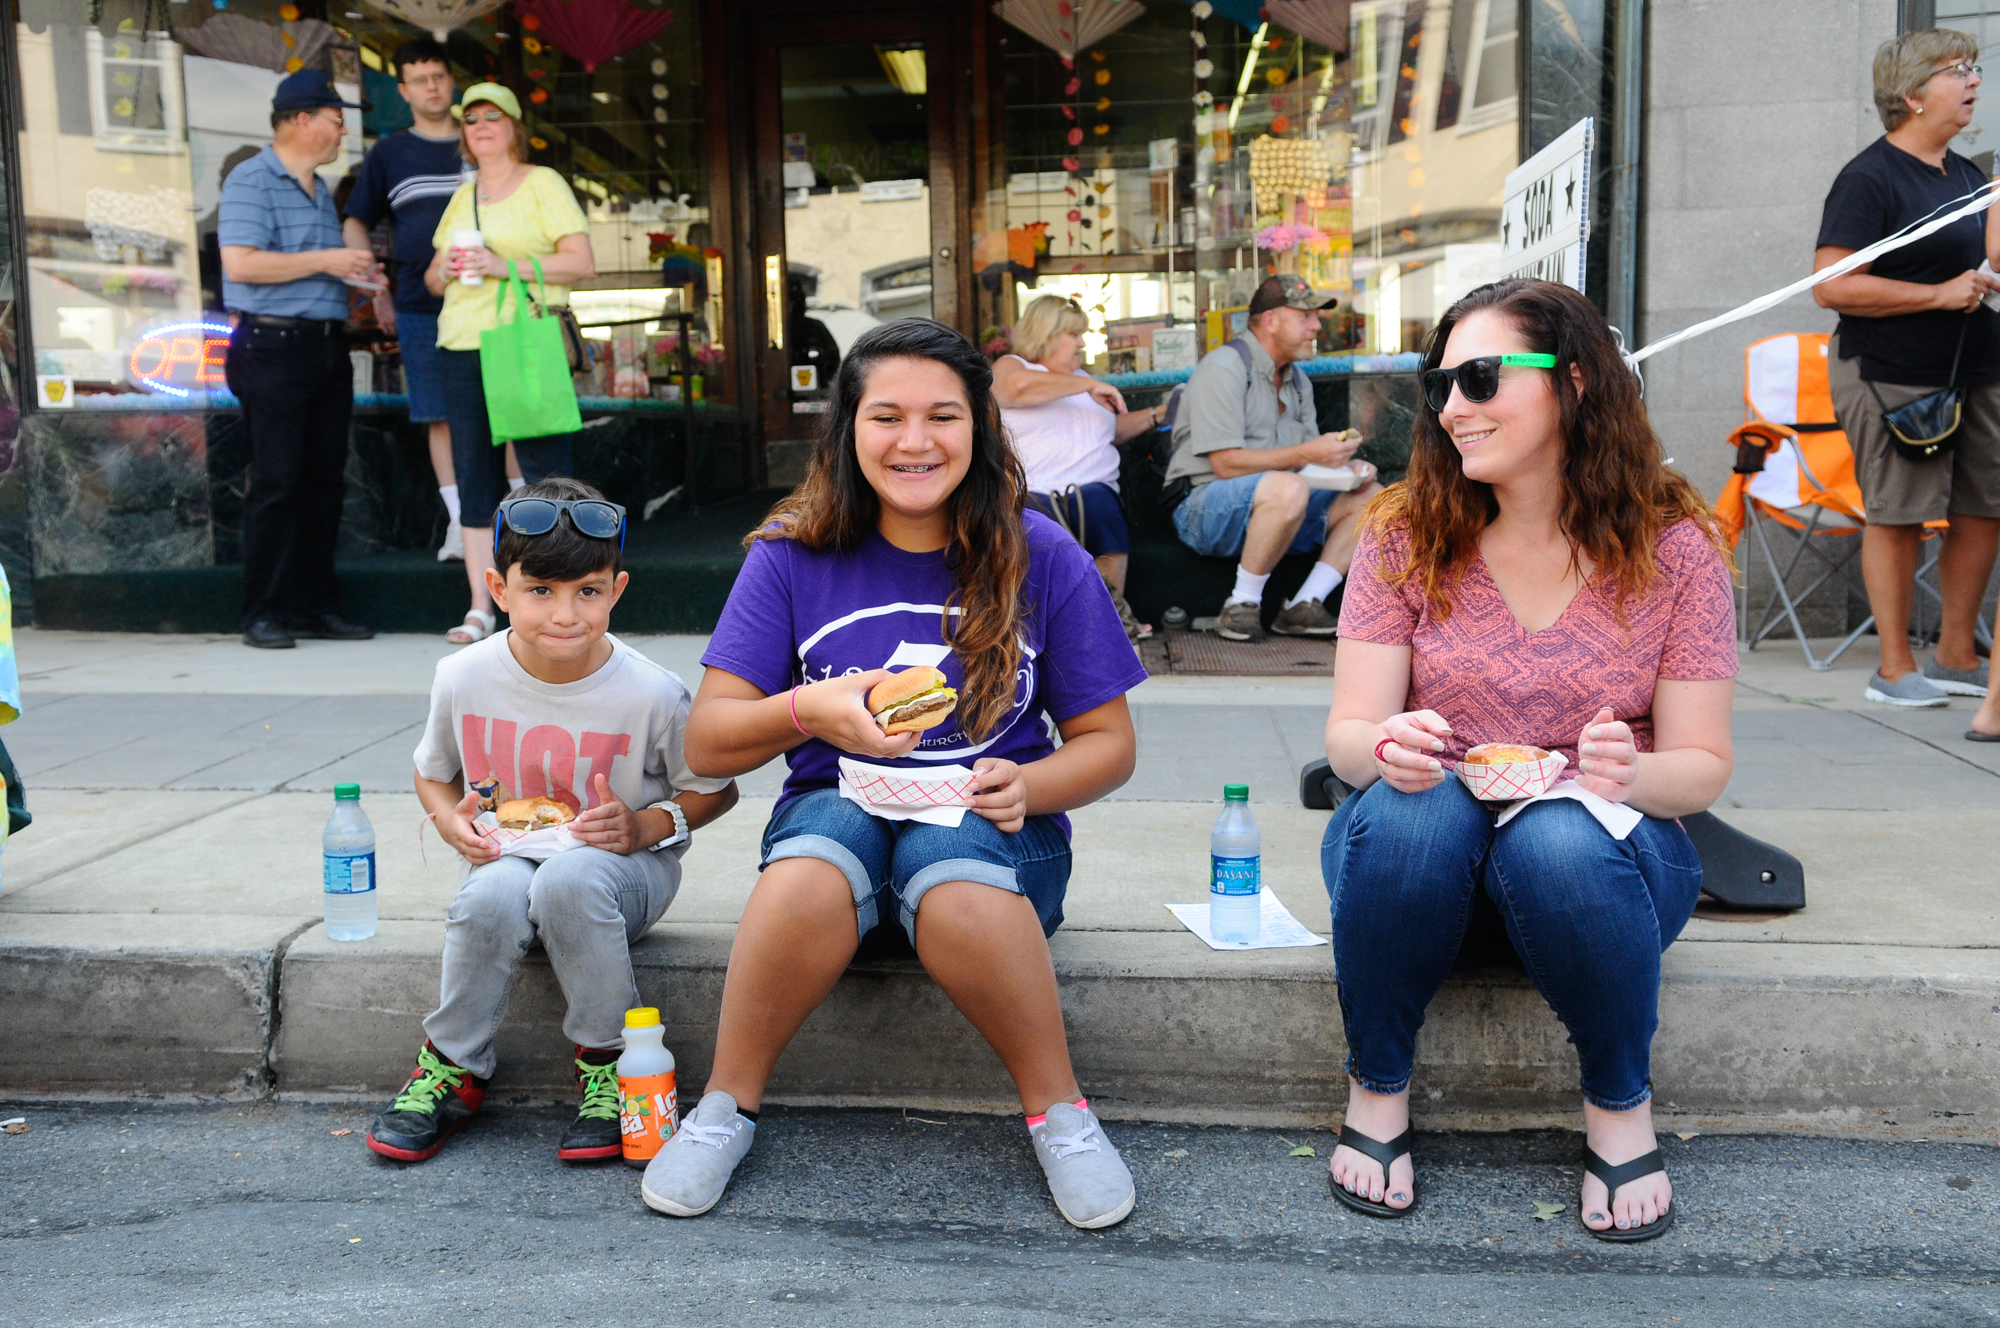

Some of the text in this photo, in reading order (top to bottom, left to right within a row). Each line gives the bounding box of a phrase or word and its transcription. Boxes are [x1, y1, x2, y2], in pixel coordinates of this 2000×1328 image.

[1523, 171, 1553, 250] SODA
[130, 337, 231, 381] OPE
[917, 730, 968, 748] HURCH
[462, 714, 631, 815] HOT
[1217, 869, 1254, 881] DASANI
[654, 1086, 677, 1117] Ic
[620, 1114, 645, 1135] ea
